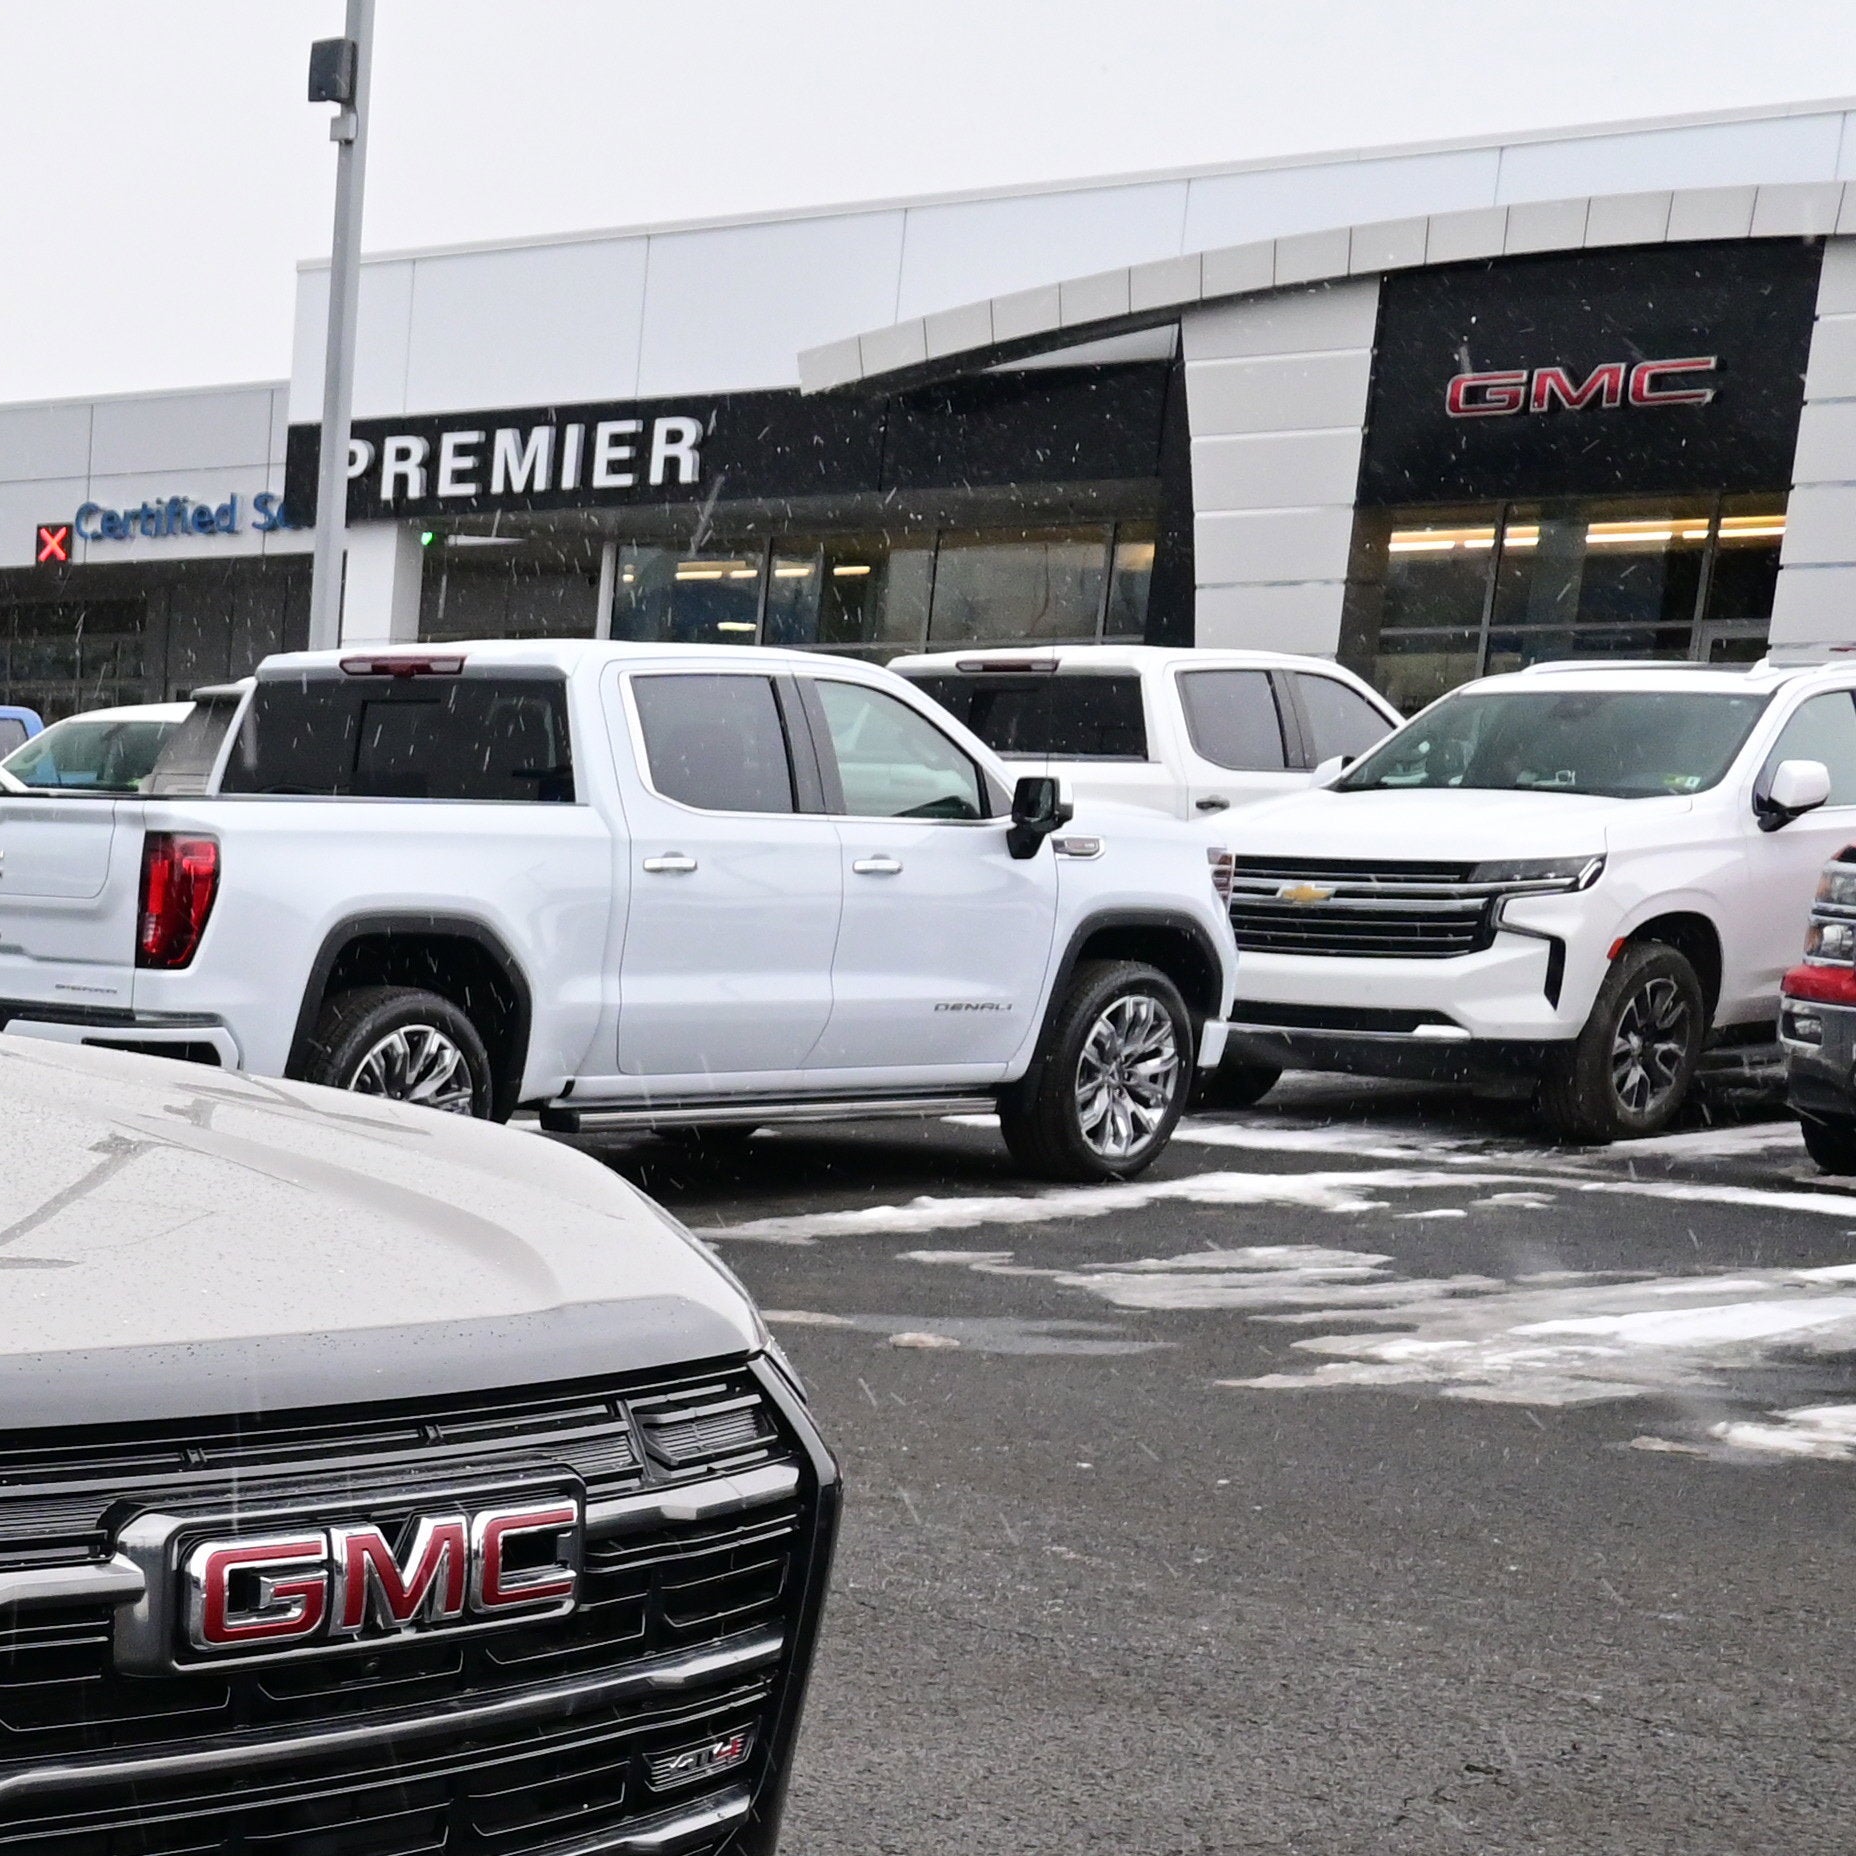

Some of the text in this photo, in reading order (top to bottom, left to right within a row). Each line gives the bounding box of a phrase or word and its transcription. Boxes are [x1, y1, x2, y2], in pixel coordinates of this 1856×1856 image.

[1445, 356, 1718, 418] GMC
[75, 493, 239, 541] Certified
[934, 1001, 1013, 1012] DENALI
[185, 1499, 579, 1652] GMC
